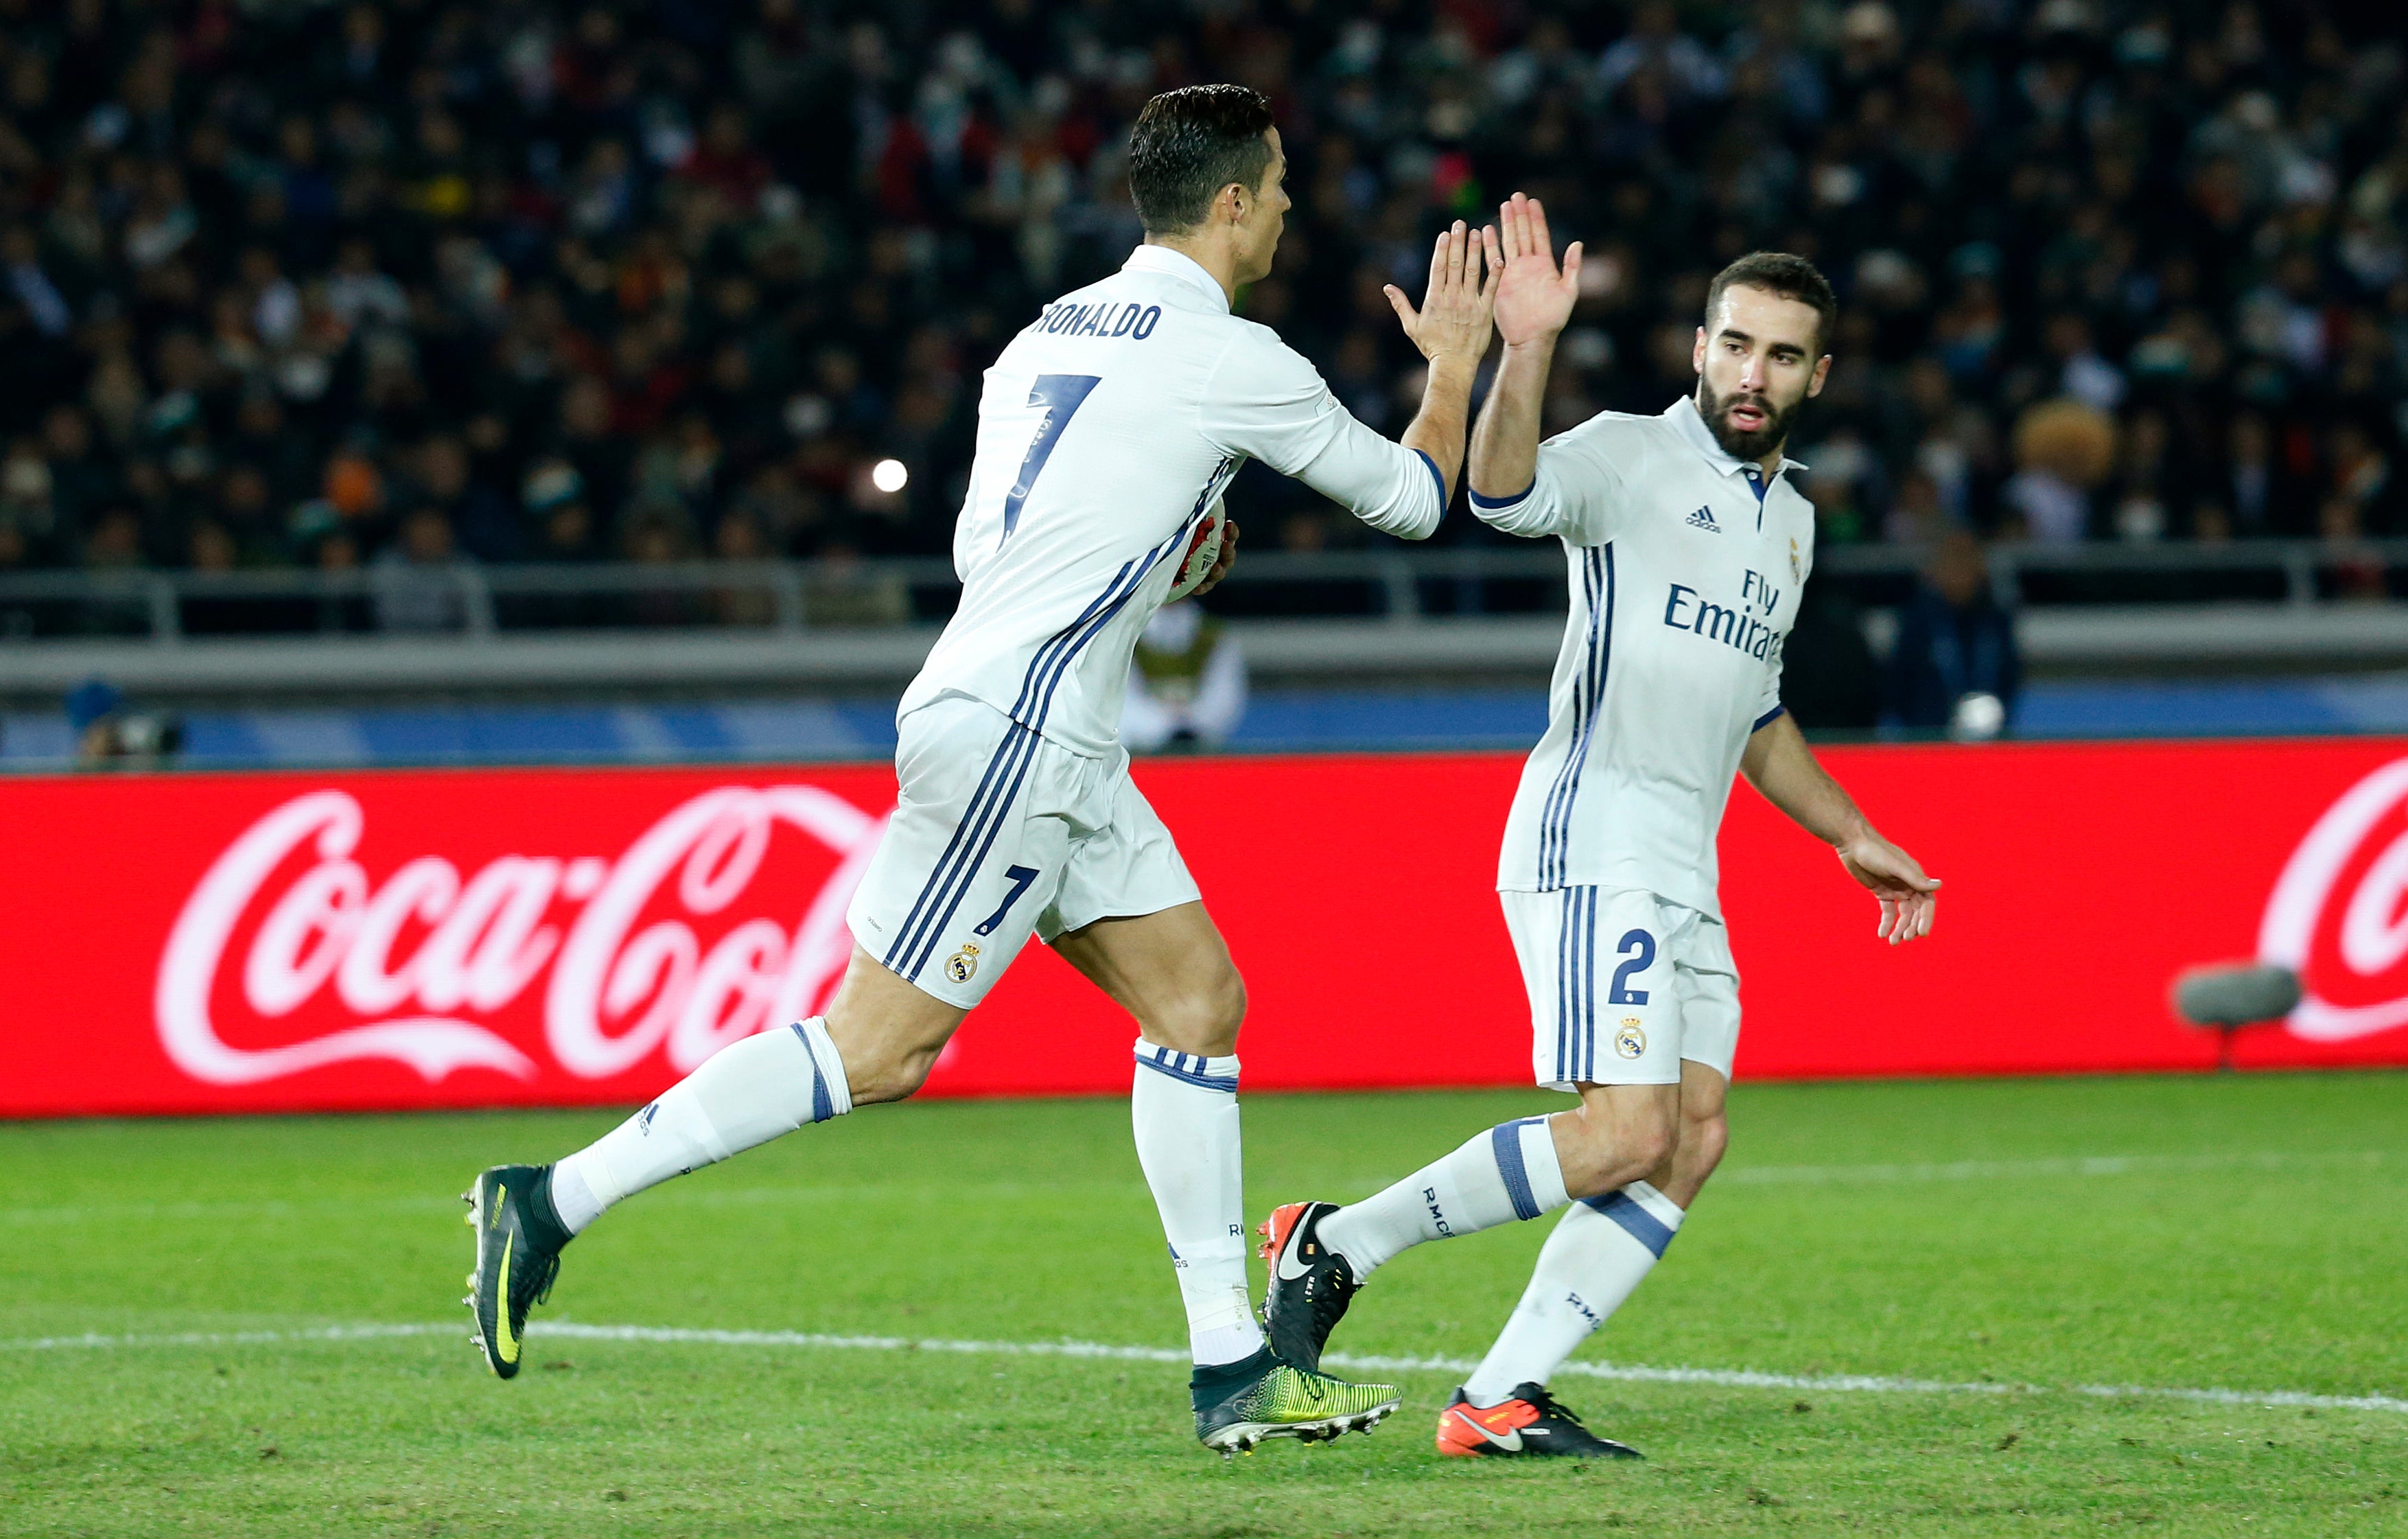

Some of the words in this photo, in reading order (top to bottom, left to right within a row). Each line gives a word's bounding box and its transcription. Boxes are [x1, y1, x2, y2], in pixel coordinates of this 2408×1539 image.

[1030, 303, 1162, 340] RONALDO
[995, 373, 1103, 555] 7
[1685, 516, 1722, 534] adidas
[1742, 568, 1779, 616] Fly
[154, 785, 891, 1085] Coca-Col
[972, 864, 1040, 937] 7
[1608, 928, 1657, 1006] 2
